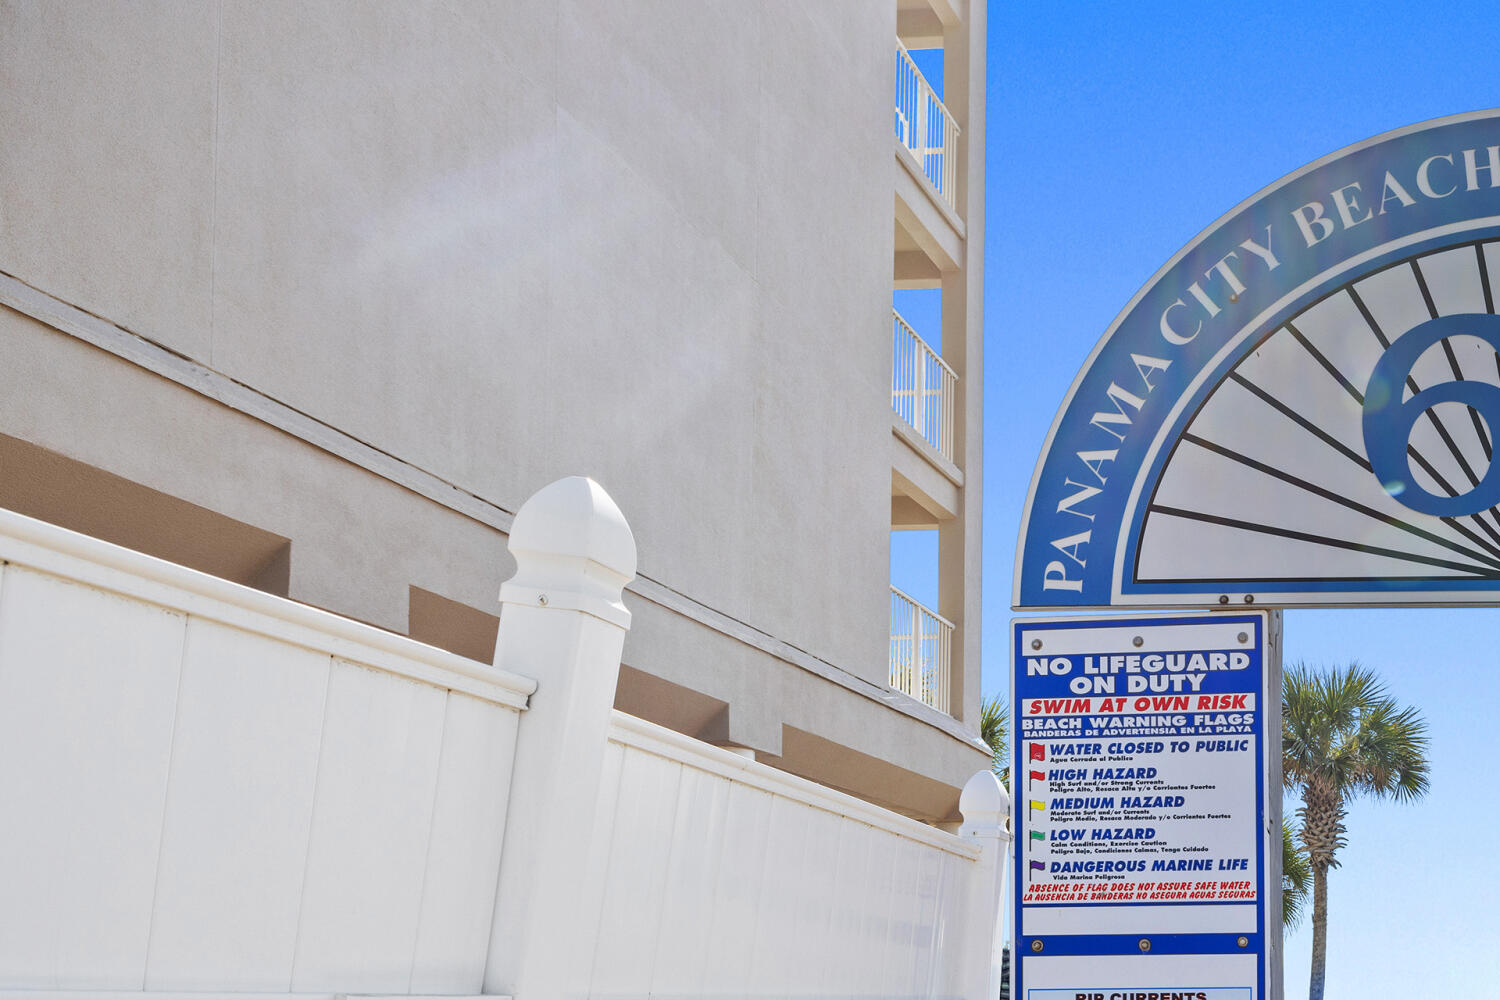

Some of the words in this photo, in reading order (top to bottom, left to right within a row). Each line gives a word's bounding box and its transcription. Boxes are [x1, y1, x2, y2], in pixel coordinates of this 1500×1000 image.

[1043, 352, 1167, 593] PANAMA
[1160, 227, 1278, 343] CITY
[1027, 658, 1072, 676] NO
[1084, 652, 1250, 674] LIFEGUARD
[1069, 676, 1115, 694] ON
[1128, 674, 1206, 692] DUTY
[1030, 700, 1090, 714] SWIM
[1099, 698, 1127, 713] AT
[1135, 697, 1189, 711] OWN
[1197, 694, 1247, 710] RISK
[1022, 719, 1081, 730] BEACH
[1090, 715, 1187, 729] WARNING
[1194, 714, 1254, 726] FLAGS
[1050, 743, 1101, 755] WATER
[1108, 742, 1164, 754] CLOSED
[1170, 741, 1189, 752] TO
[1194, 740, 1248, 752] PUBLIC
[1049, 769, 1087, 780] HIGH
[1093, 768, 1157, 780] HAZARD
[1050, 798, 1114, 809] MEDIUM
[1121, 796, 1185, 808] HAZARD
[1050, 830, 1085, 841] LOW
[1091, 828, 1156, 840] HAZARD
[1050, 860, 1146, 873] DANGEROUS
[1152, 860, 1212, 871] MARINE
[1218, 859, 1248, 870] LIFE
[1029, 884, 1070, 893] ABSENCE
[1073, 884, 1084, 892] OF
[1087, 883, 1108, 891] FLAG
[1110, 883, 1135, 891] DOES
[1138, 883, 1153, 891] NOT
[1156, 882, 1192, 890] ASSURE
[1194, 882, 1218, 890] SAFE
[1220, 881, 1250, 890] WATER
